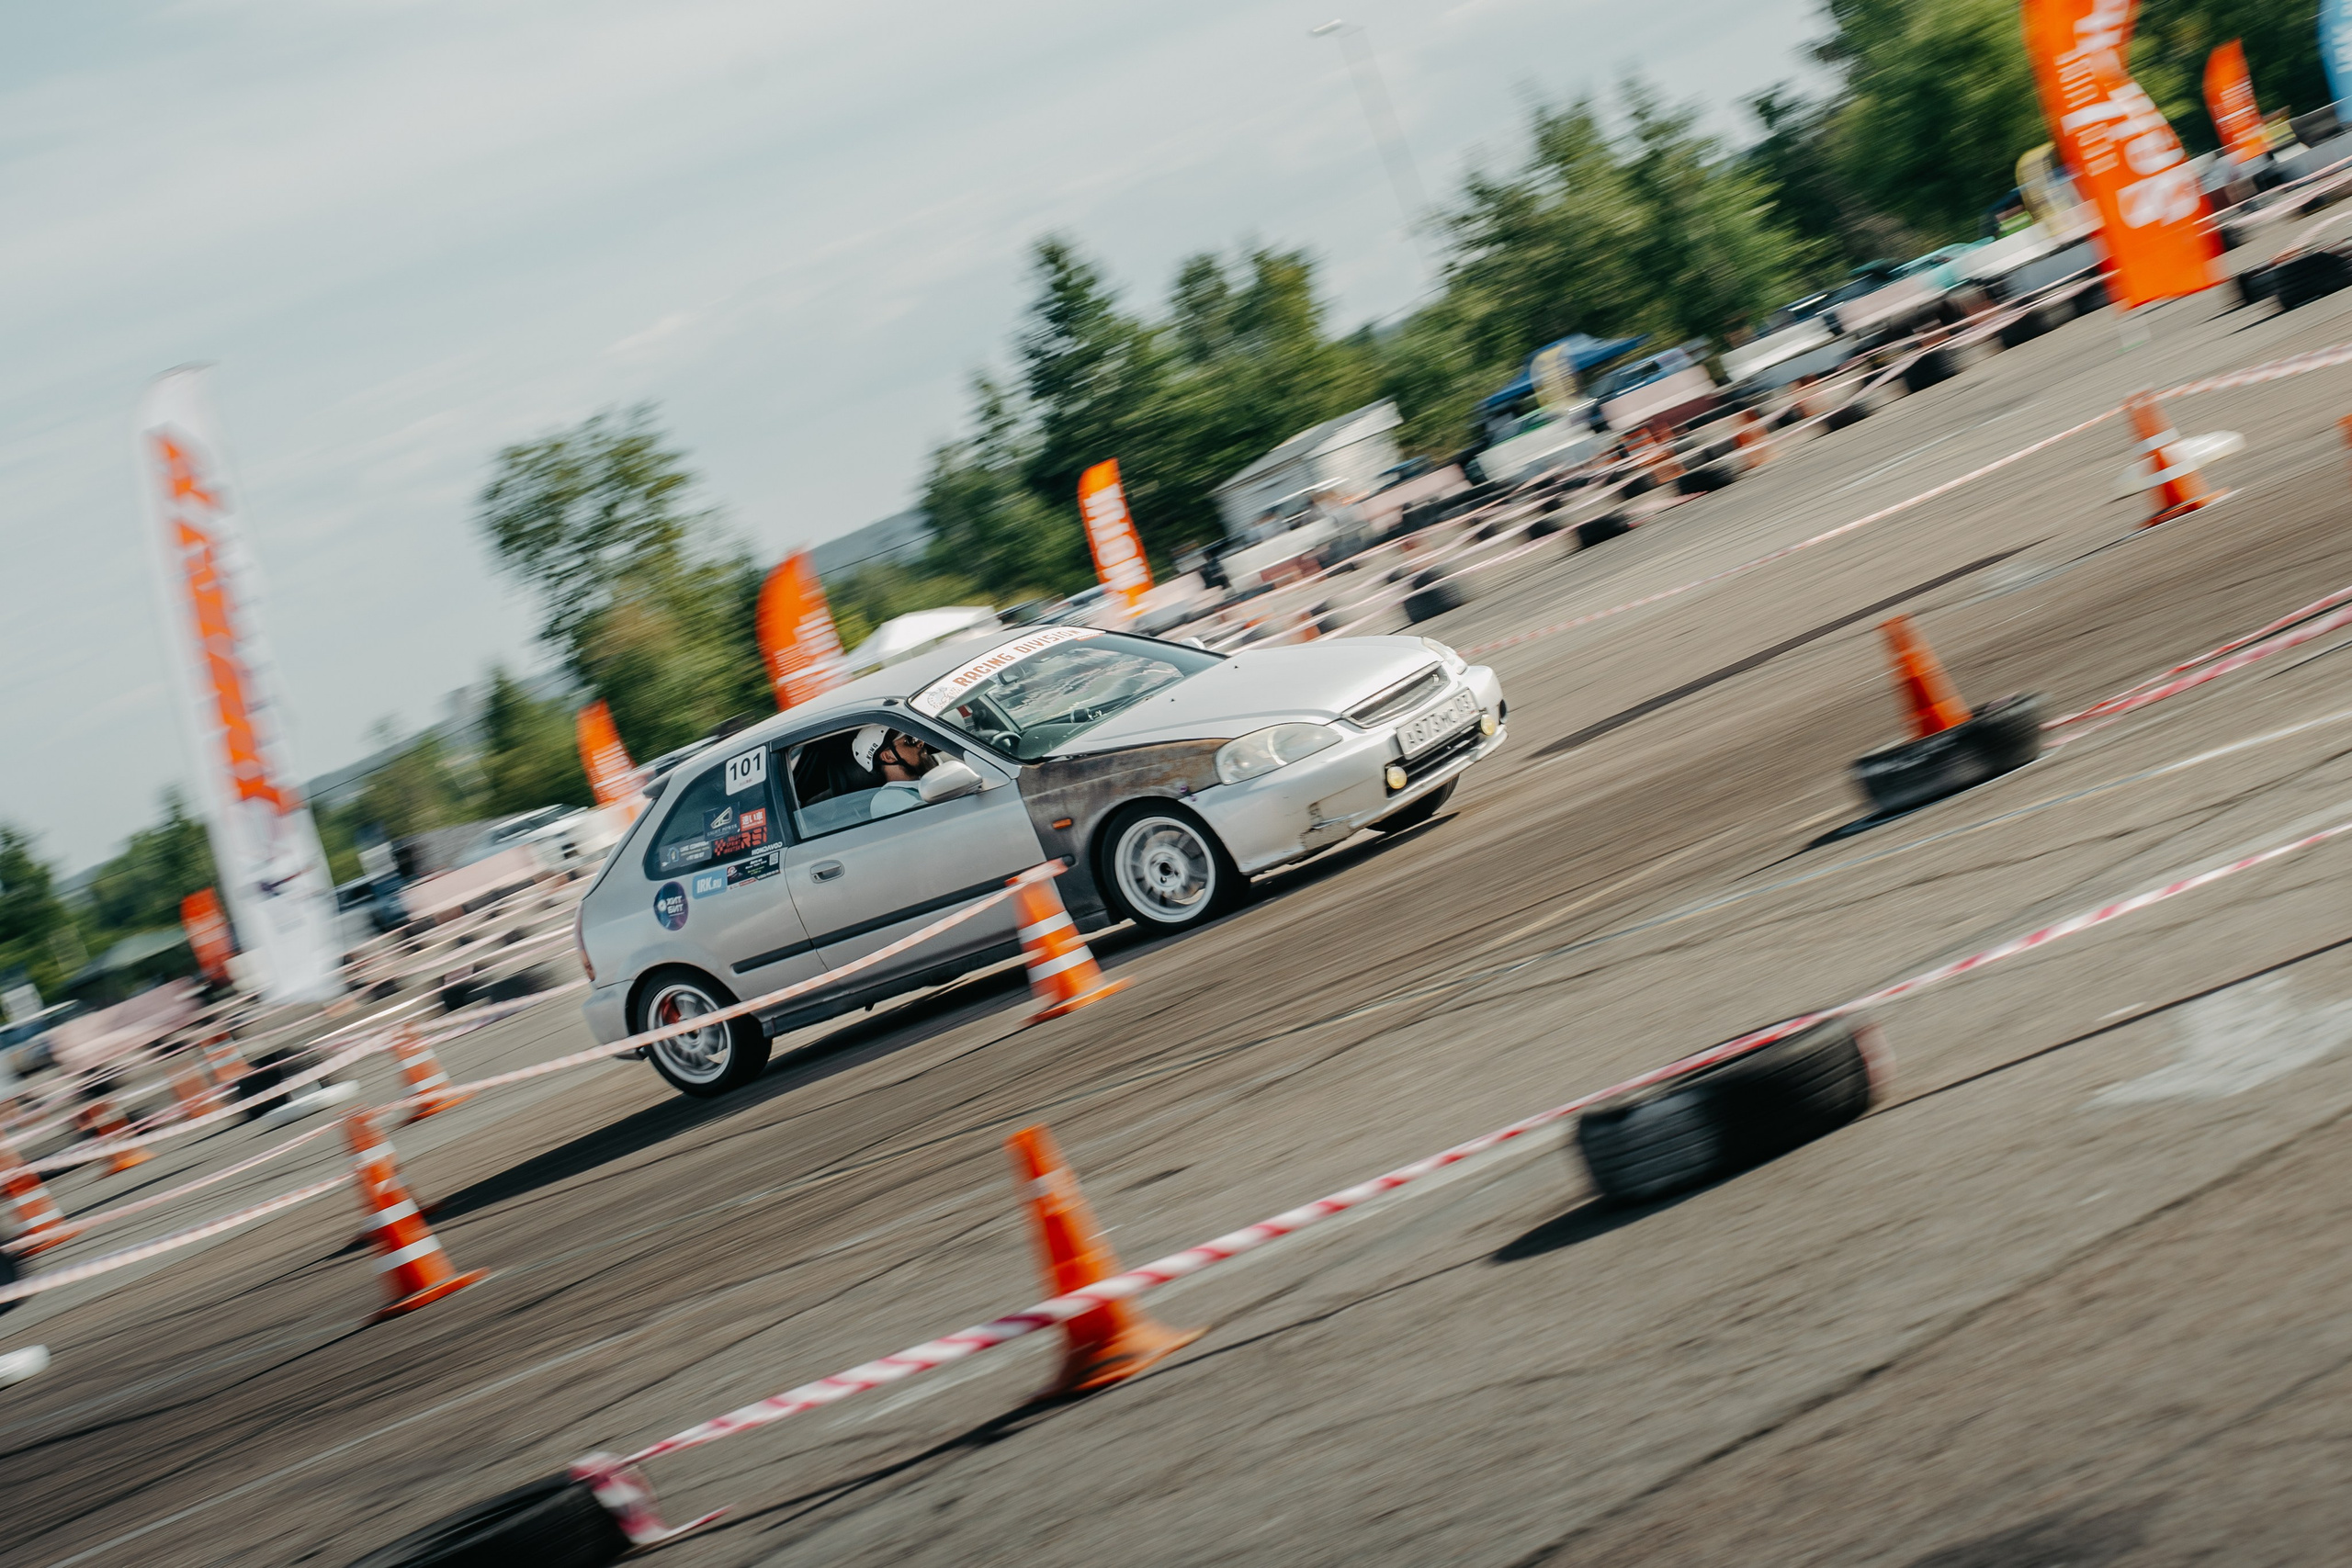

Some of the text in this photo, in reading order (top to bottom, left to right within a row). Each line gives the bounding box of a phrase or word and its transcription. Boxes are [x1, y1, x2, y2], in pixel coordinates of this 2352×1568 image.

[952, 628, 1082, 687] RACING DIVISION
[729, 751, 761, 781] 101
[696, 876, 722, 894] IRK.RU
[666, 895, 683, 906] ХИТ
[667, 904, 684, 915] БИТ
